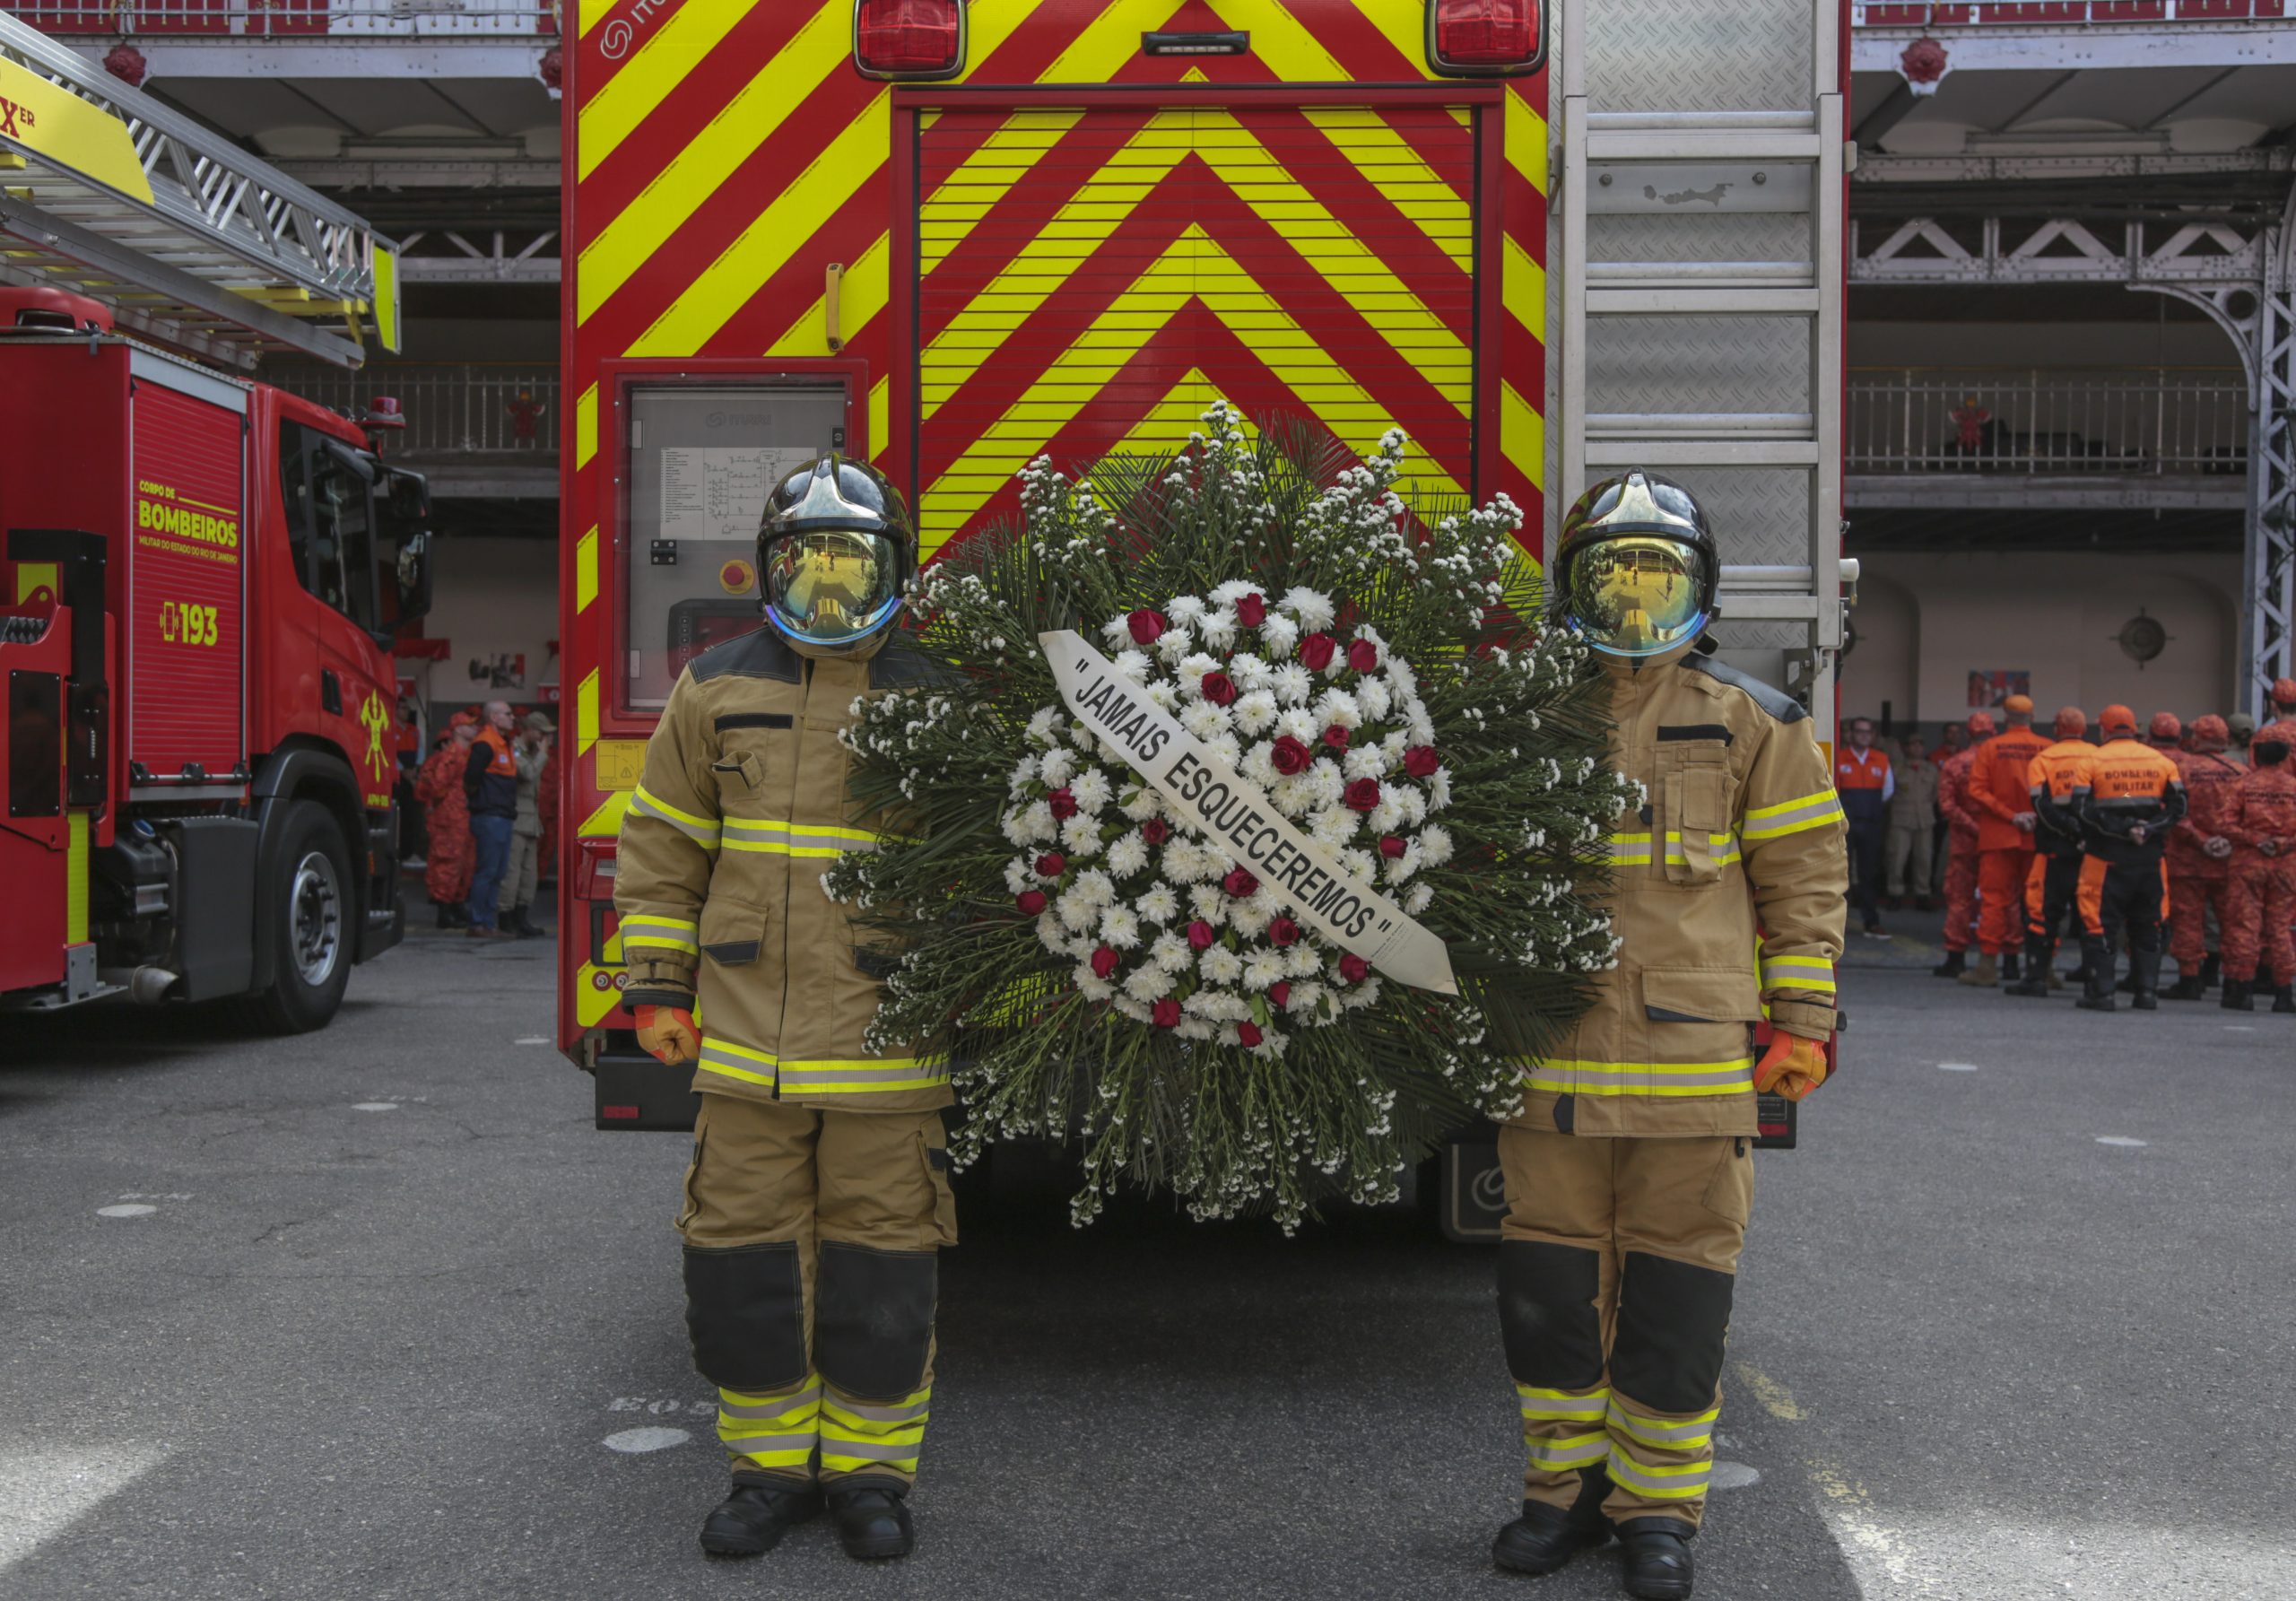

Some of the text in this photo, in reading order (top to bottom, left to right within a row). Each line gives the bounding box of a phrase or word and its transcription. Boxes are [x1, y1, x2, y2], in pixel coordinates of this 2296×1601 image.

[139, 480, 176, 500] CORPO DE
[139, 500, 238, 548] BOMBEIROS
[139, 535, 161, 547] MILITAR
[161, 540, 170, 550] DO
[170, 542, 191, 554] ESTADO
[191, 546, 200, 556] DO
[179, 603, 218, 647] 193
[2112, 781, 2154, 791] MILITAR
